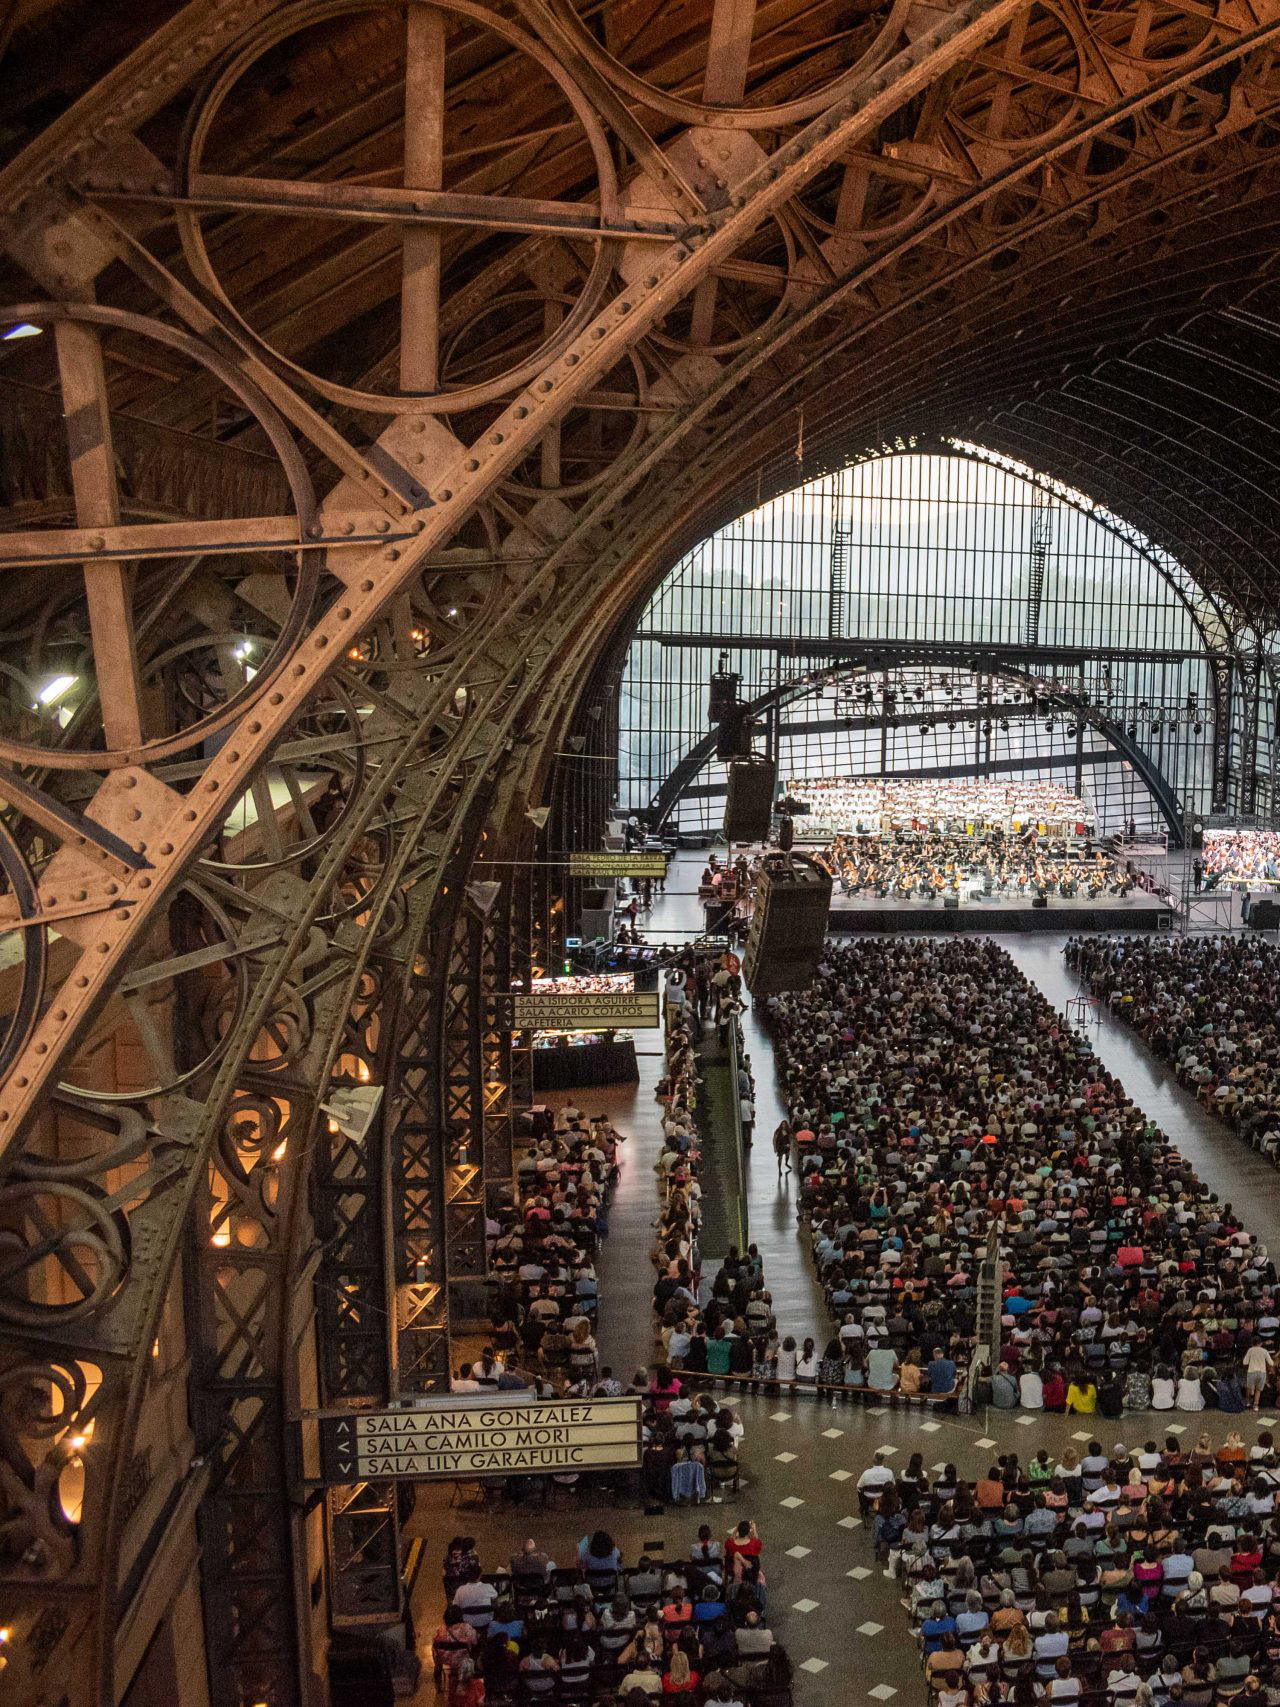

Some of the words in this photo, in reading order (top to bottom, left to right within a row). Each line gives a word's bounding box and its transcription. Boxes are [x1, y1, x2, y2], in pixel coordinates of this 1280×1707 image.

[519, 997, 545, 1006] SALA
[550, 996, 591, 1006] ISIDORA
[595, 996, 640, 1005] AGUIRRE
[519, 1008, 545, 1017] SALA
[549, 1007, 590, 1016] ACARIO
[593, 1006, 643, 1016] COTAPOS
[519, 1018, 573, 1027] CAFETERIA
[366, 1417, 417, 1434] SALA
[425, 1413, 472, 1430] ANA
[480, 1407, 593, 1427] GONZALEZ
[367, 1436, 418, 1454] SALA
[425, 1432, 507, 1450] CAMILO
[515, 1429, 570, 1446] MORI
[368, 1456, 419, 1474] SALA
[427, 1453, 462, 1471] LILY
[470, 1447, 584, 1468] GARAFULIC
